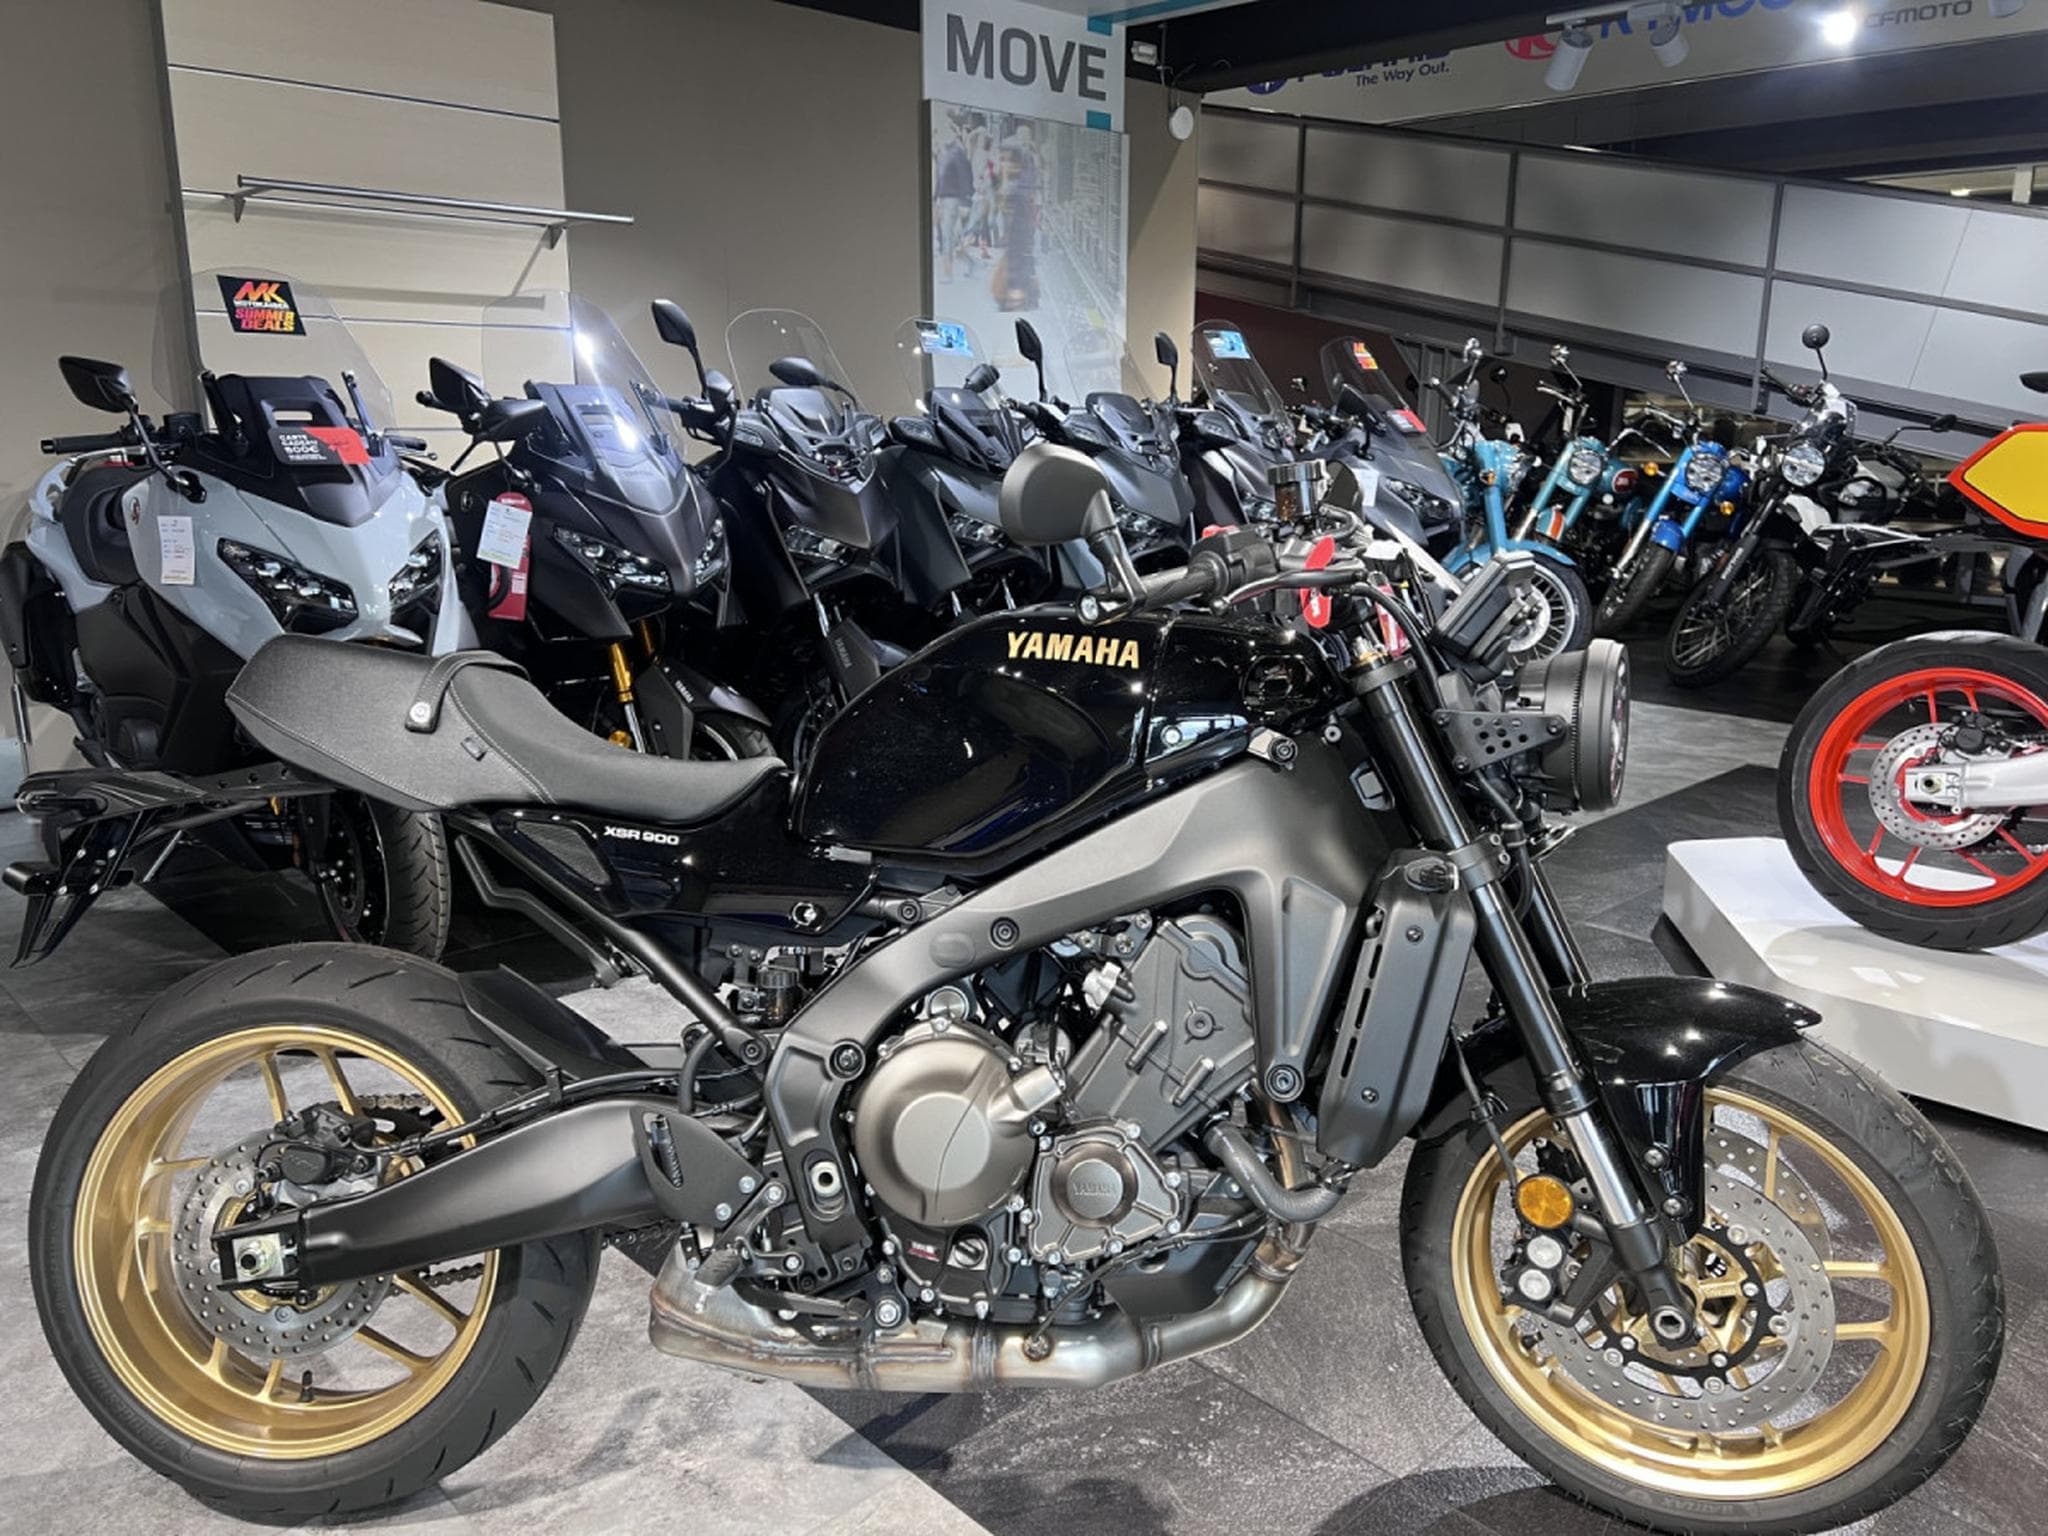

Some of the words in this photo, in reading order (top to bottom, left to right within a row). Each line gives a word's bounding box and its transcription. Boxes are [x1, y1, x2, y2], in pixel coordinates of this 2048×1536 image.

[946, 13, 1106, 101] MOVE
[1356, 74, 1379, 87] The
[1383, 68, 1414, 82] Way
[1419, 61, 1450, 76] Out.
[235, 308, 295, 322] SUMMER
[241, 319, 294, 332] DEALS
[1008, 631, 1139, 669] YAMAHA
[603, 826, 640, 840] XSR
[642, 830, 680, 846] 900
